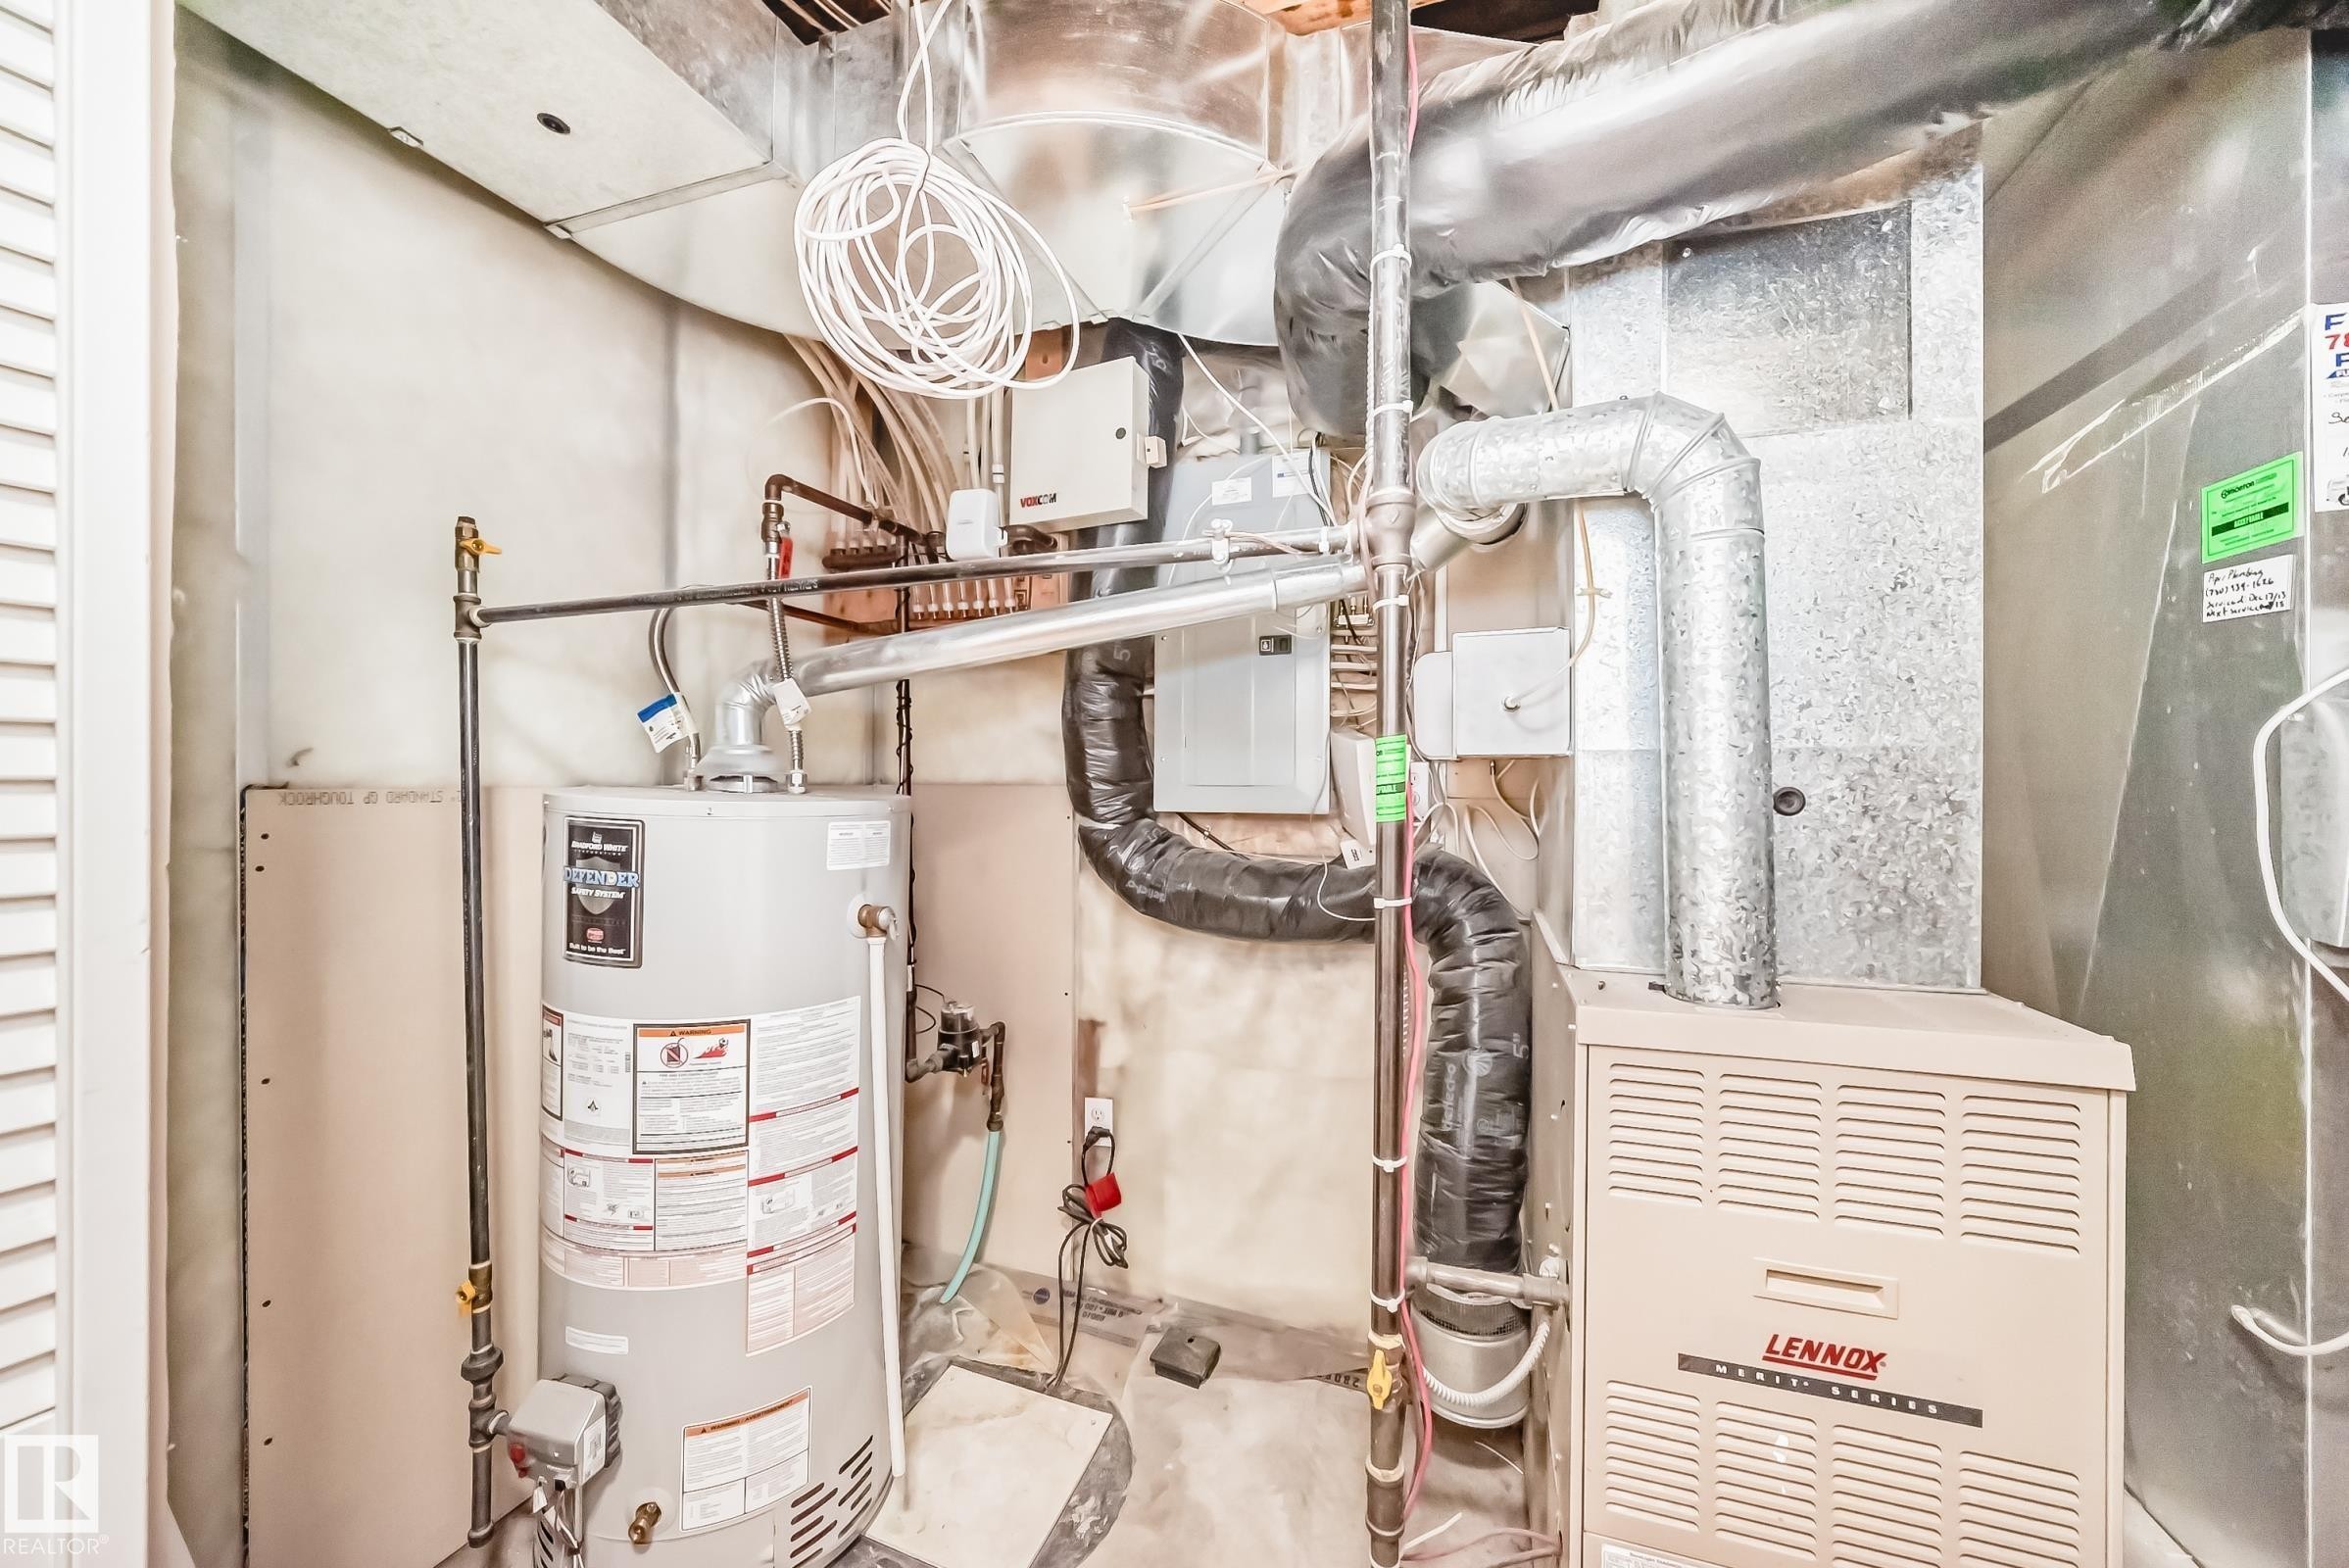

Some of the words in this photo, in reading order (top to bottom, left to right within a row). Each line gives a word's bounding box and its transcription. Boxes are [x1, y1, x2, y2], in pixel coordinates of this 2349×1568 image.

[1020, 493, 1056, 508] VOXCOM
[278, 792, 354, 806] TOUGHROCK
[563, 867, 640, 888] DEFENDER
[1765, 1334, 1886, 1373] LENNOX
[1832, 1386, 1937, 1414] SERIES
